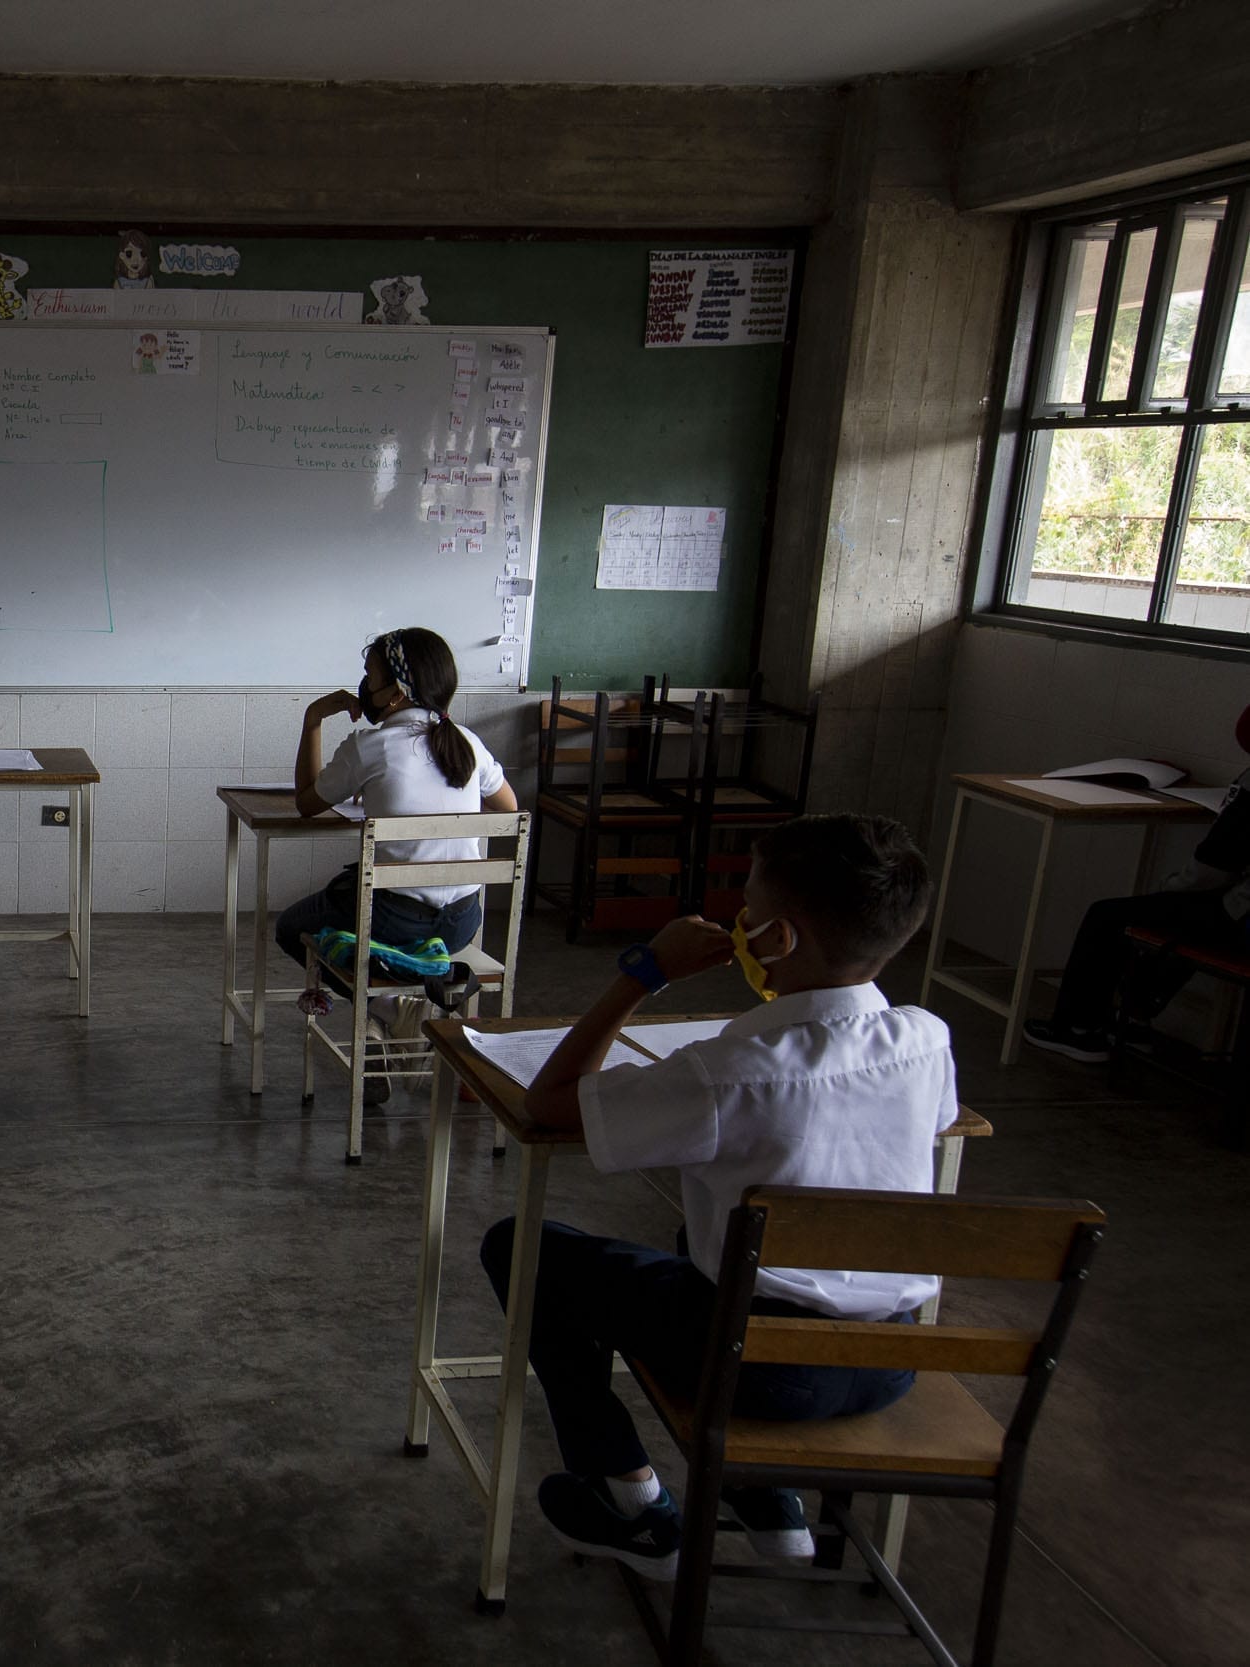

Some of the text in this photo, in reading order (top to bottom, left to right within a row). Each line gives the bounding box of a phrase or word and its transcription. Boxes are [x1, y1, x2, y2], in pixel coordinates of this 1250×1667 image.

[650, 268, 696, 284] MONDAY
[650, 283, 690, 296] TUESDAY
[32, 291, 108, 317] Enthusiasm
[289, 293, 343, 319] world
[646, 332, 685, 344] SUNDAY
[232, 339, 420, 372] Lenguaje y Comunicación
[4, 368, 42, 383] Nombre
[233, 379, 325, 401] Matemática
[490, 381, 524, 394] whispered
[237, 415, 396, 443] Dibujo representación de
[294, 437, 313, 450] tus
[319, 440, 380, 451] emociones
[295, 454, 403, 470] tiempo de Covid-19
[501, 451, 514, 463] And
[508, 547, 519, 556] let
[506, 597, 514, 605] no
